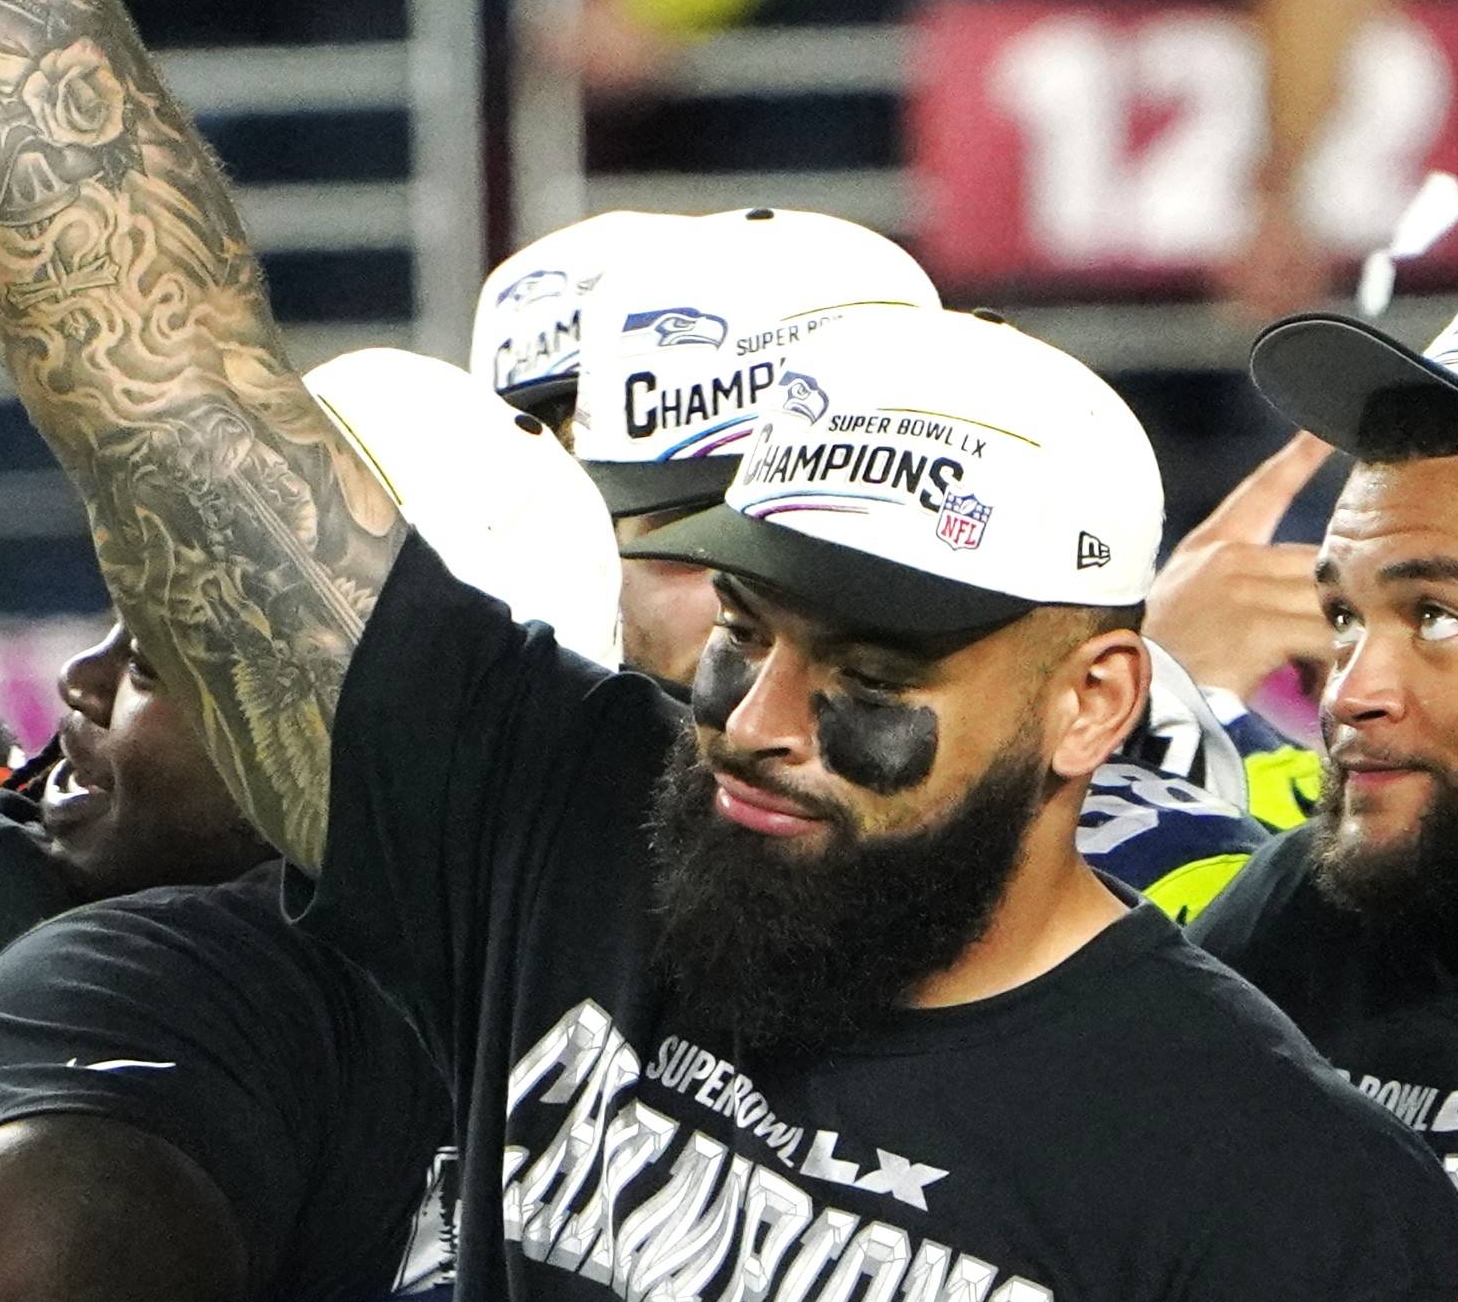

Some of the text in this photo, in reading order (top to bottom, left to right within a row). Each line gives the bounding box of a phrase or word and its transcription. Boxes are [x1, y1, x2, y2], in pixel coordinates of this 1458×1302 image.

[736, 327, 800, 357] SUPER
[625, 357, 787, 440] CHAMP
[742, 422, 966, 515] CHAMPIONS
[828, 414, 987, 460] SUPER BOWL LX
[940, 514, 978, 547] NFL
[799, 1128, 951, 1213] LX
